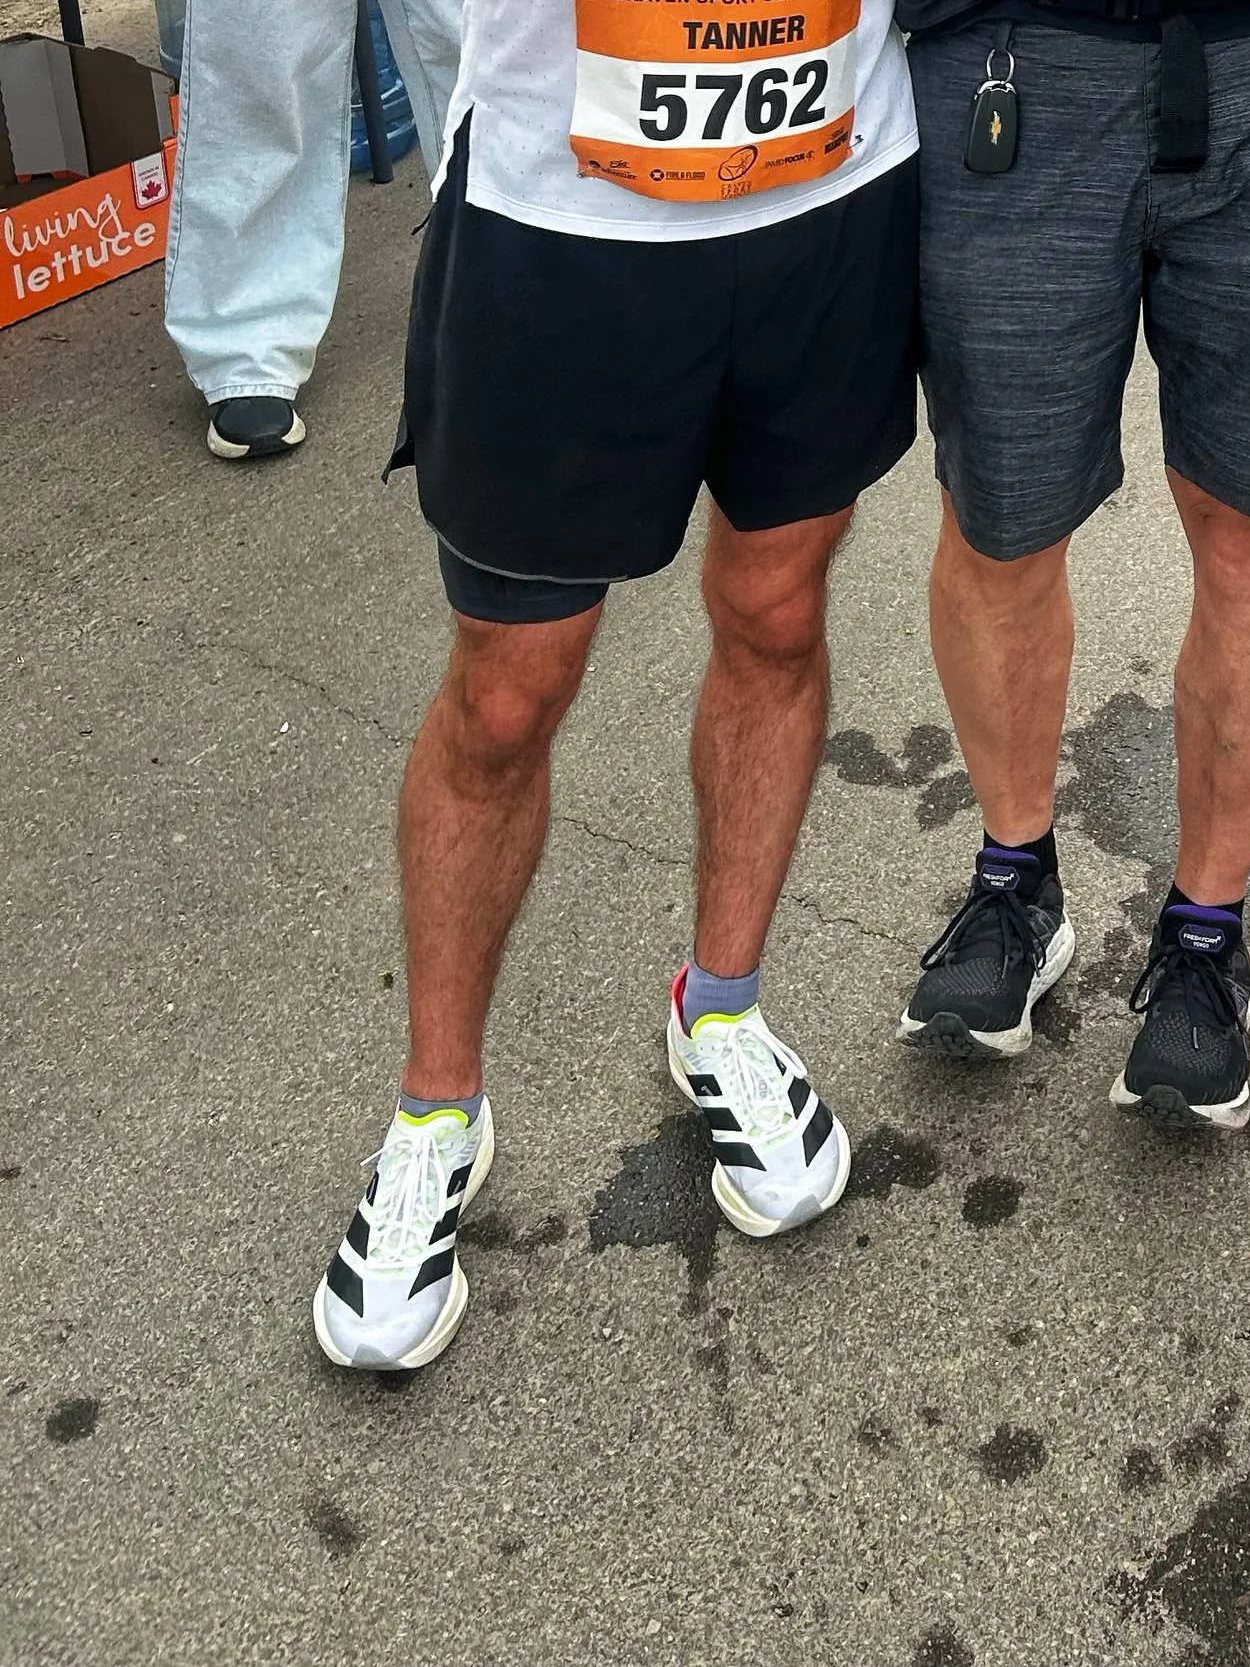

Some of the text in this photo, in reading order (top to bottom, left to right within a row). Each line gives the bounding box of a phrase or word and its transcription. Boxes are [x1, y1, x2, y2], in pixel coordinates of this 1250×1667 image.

[683, 14, 806, 50] TANNER
[638, 59, 829, 142] 5762
[4, 193, 130, 258] living
[11, 222, 157, 301] lettuce
